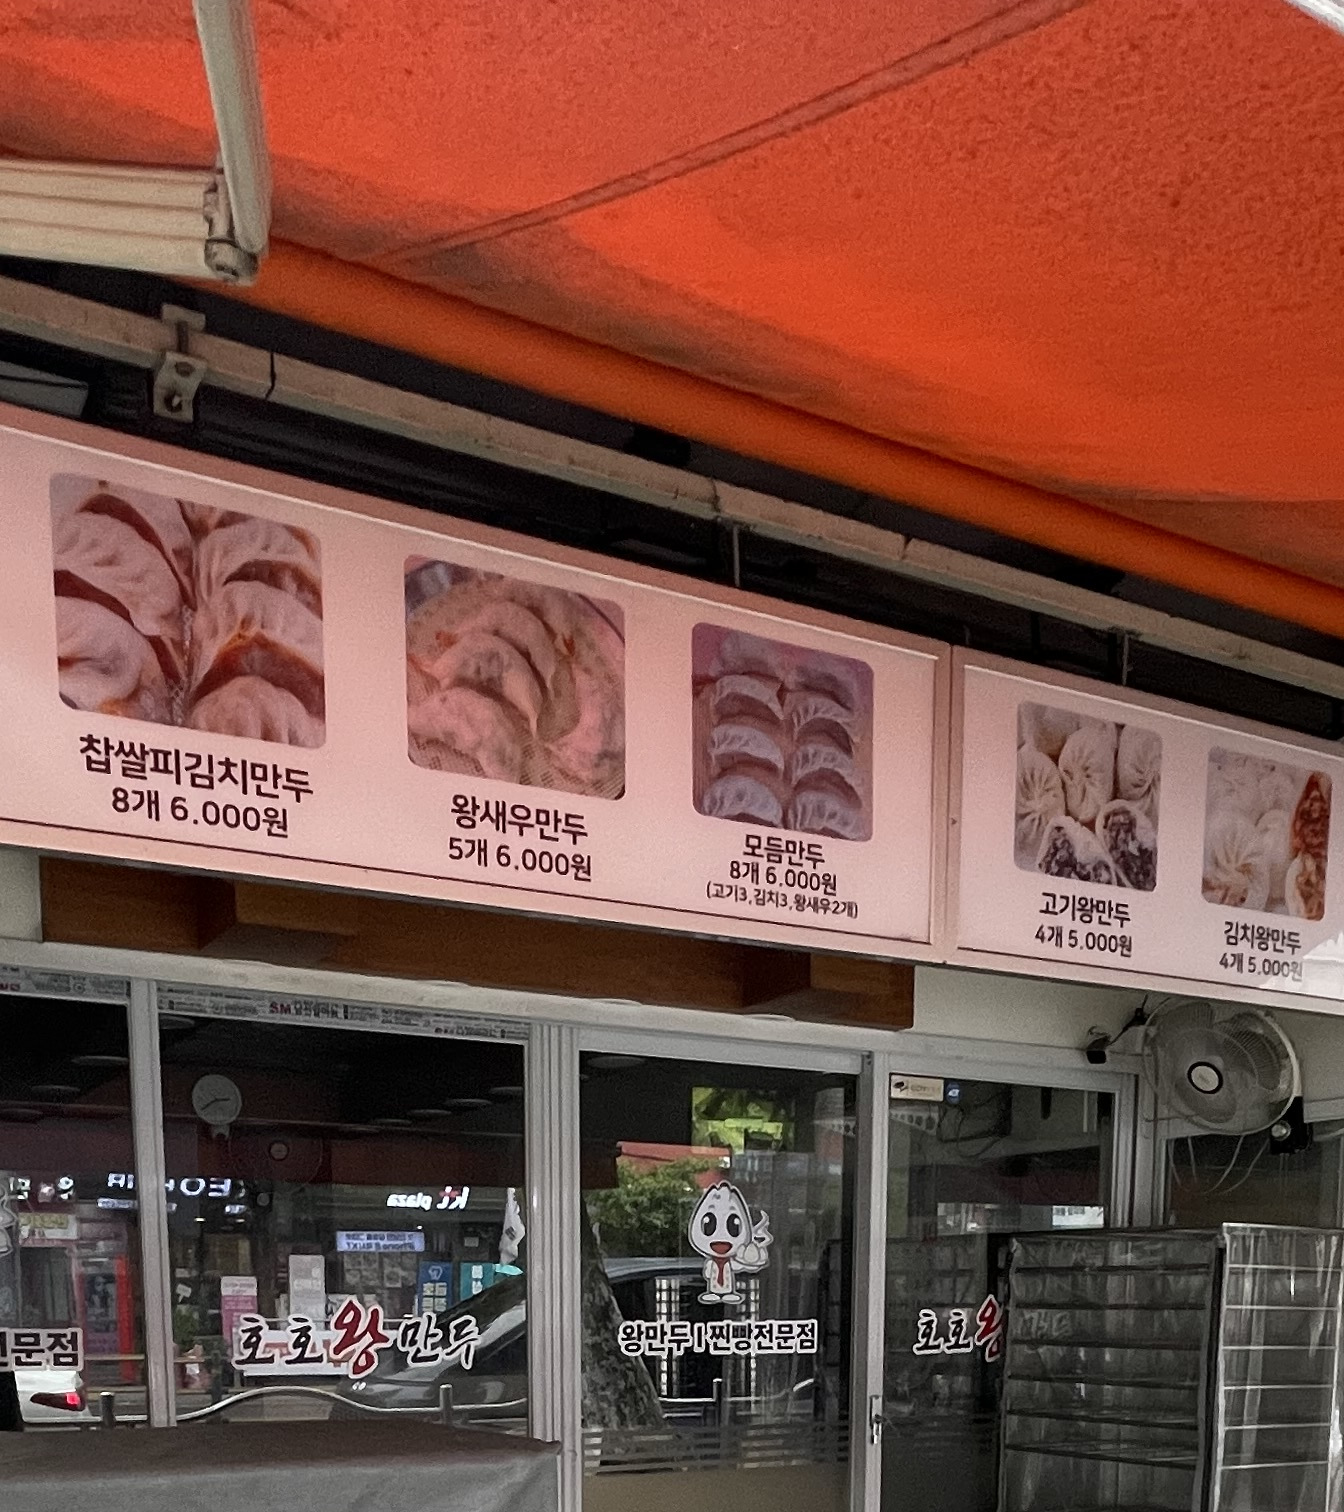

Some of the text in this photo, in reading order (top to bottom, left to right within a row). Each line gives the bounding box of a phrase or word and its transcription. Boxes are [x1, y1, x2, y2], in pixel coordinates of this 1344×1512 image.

[79, 734, 314, 803] 찹쌀피김치만두
[111, 788, 290, 838] 8개 6.000원
[450, 796, 588, 845] 왕새우만두
[448, 838, 592, 882] 5개 6.000원
[743, 834, 825, 869] 모듬만두
[730, 860, 837, 896] 8개 6.000원
[1039, 892, 1131, 928] 고기왕만두
[1035, 924, 1133, 958] 4개 5.000원
[1223, 921, 1301, 954] 김치왕만두
[1219, 952, 1303, 982] 4개 5.000원
[618, 1319, 818, 1356] 왕만두 찐빵전문점
